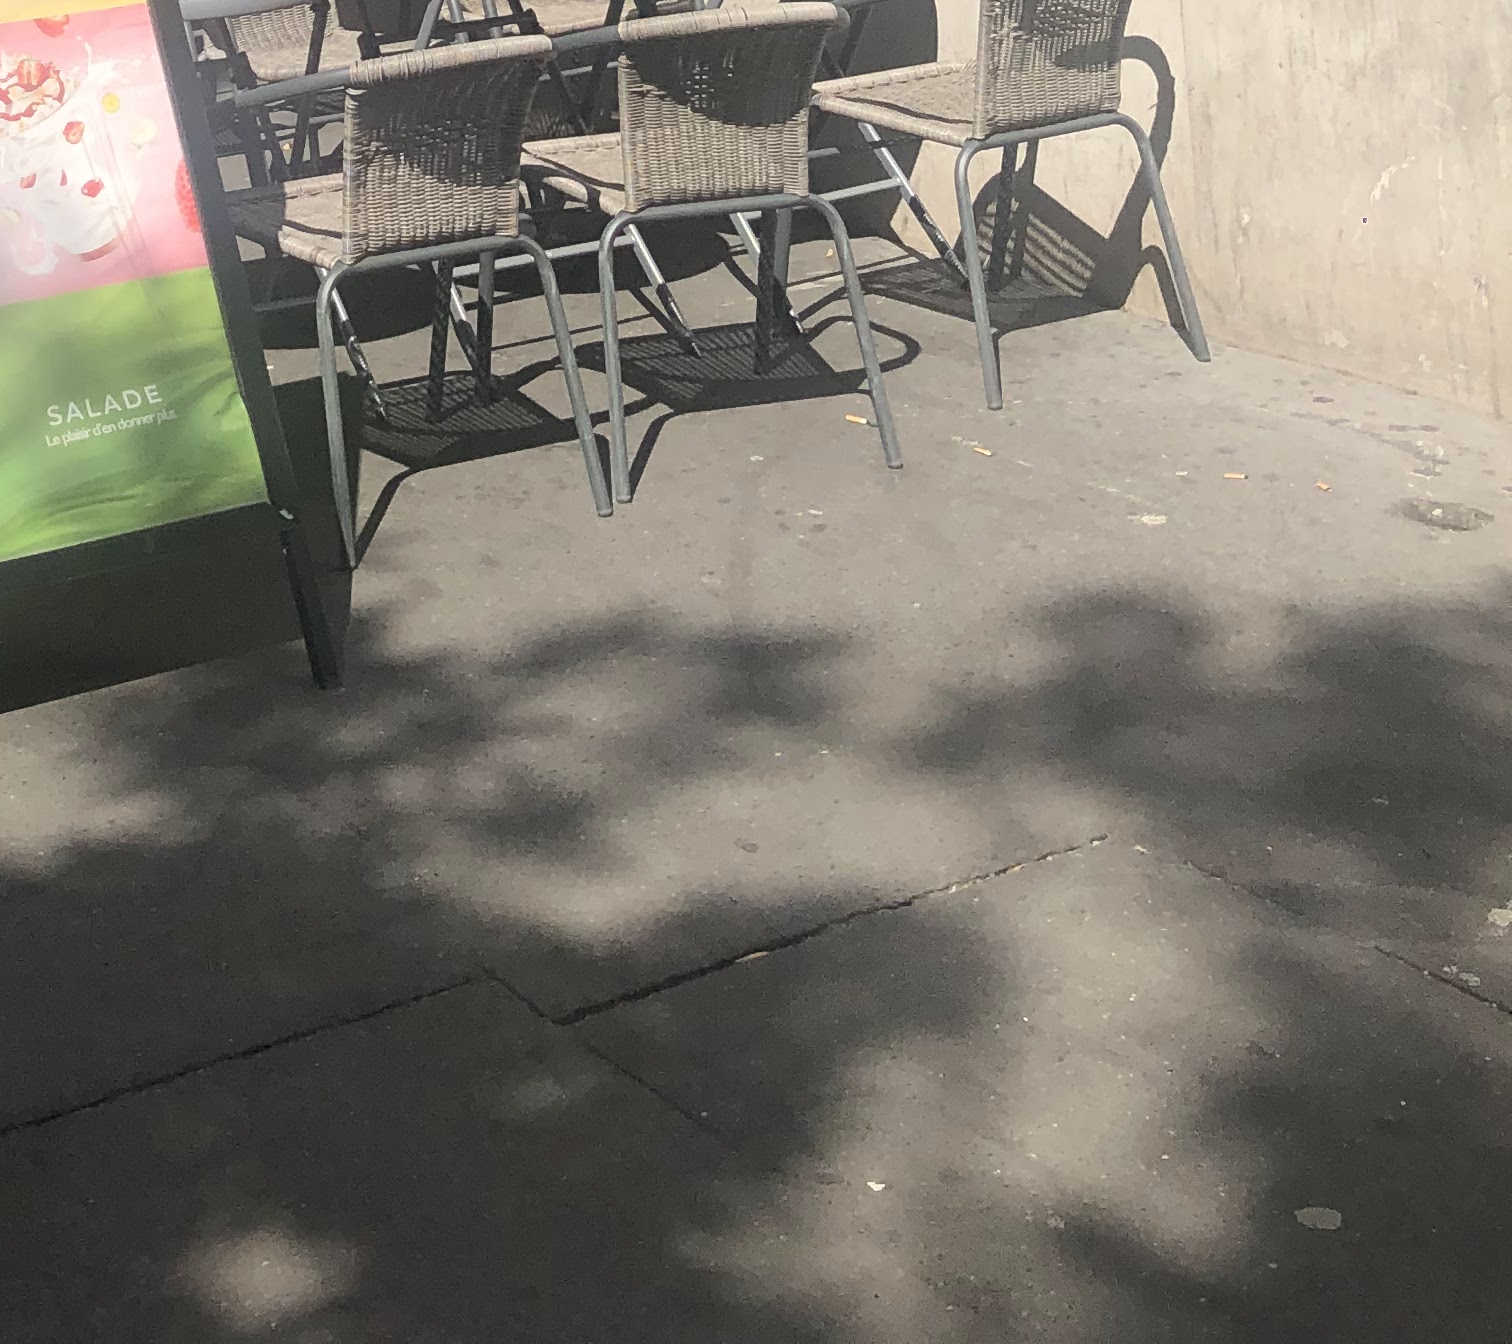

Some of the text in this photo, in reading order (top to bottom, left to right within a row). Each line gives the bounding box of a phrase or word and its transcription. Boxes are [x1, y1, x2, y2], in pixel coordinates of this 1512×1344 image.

[47, 384, 162, 426] SALADE
[45, 435, 60, 446] Le
[118, 413, 155, 429] donner
